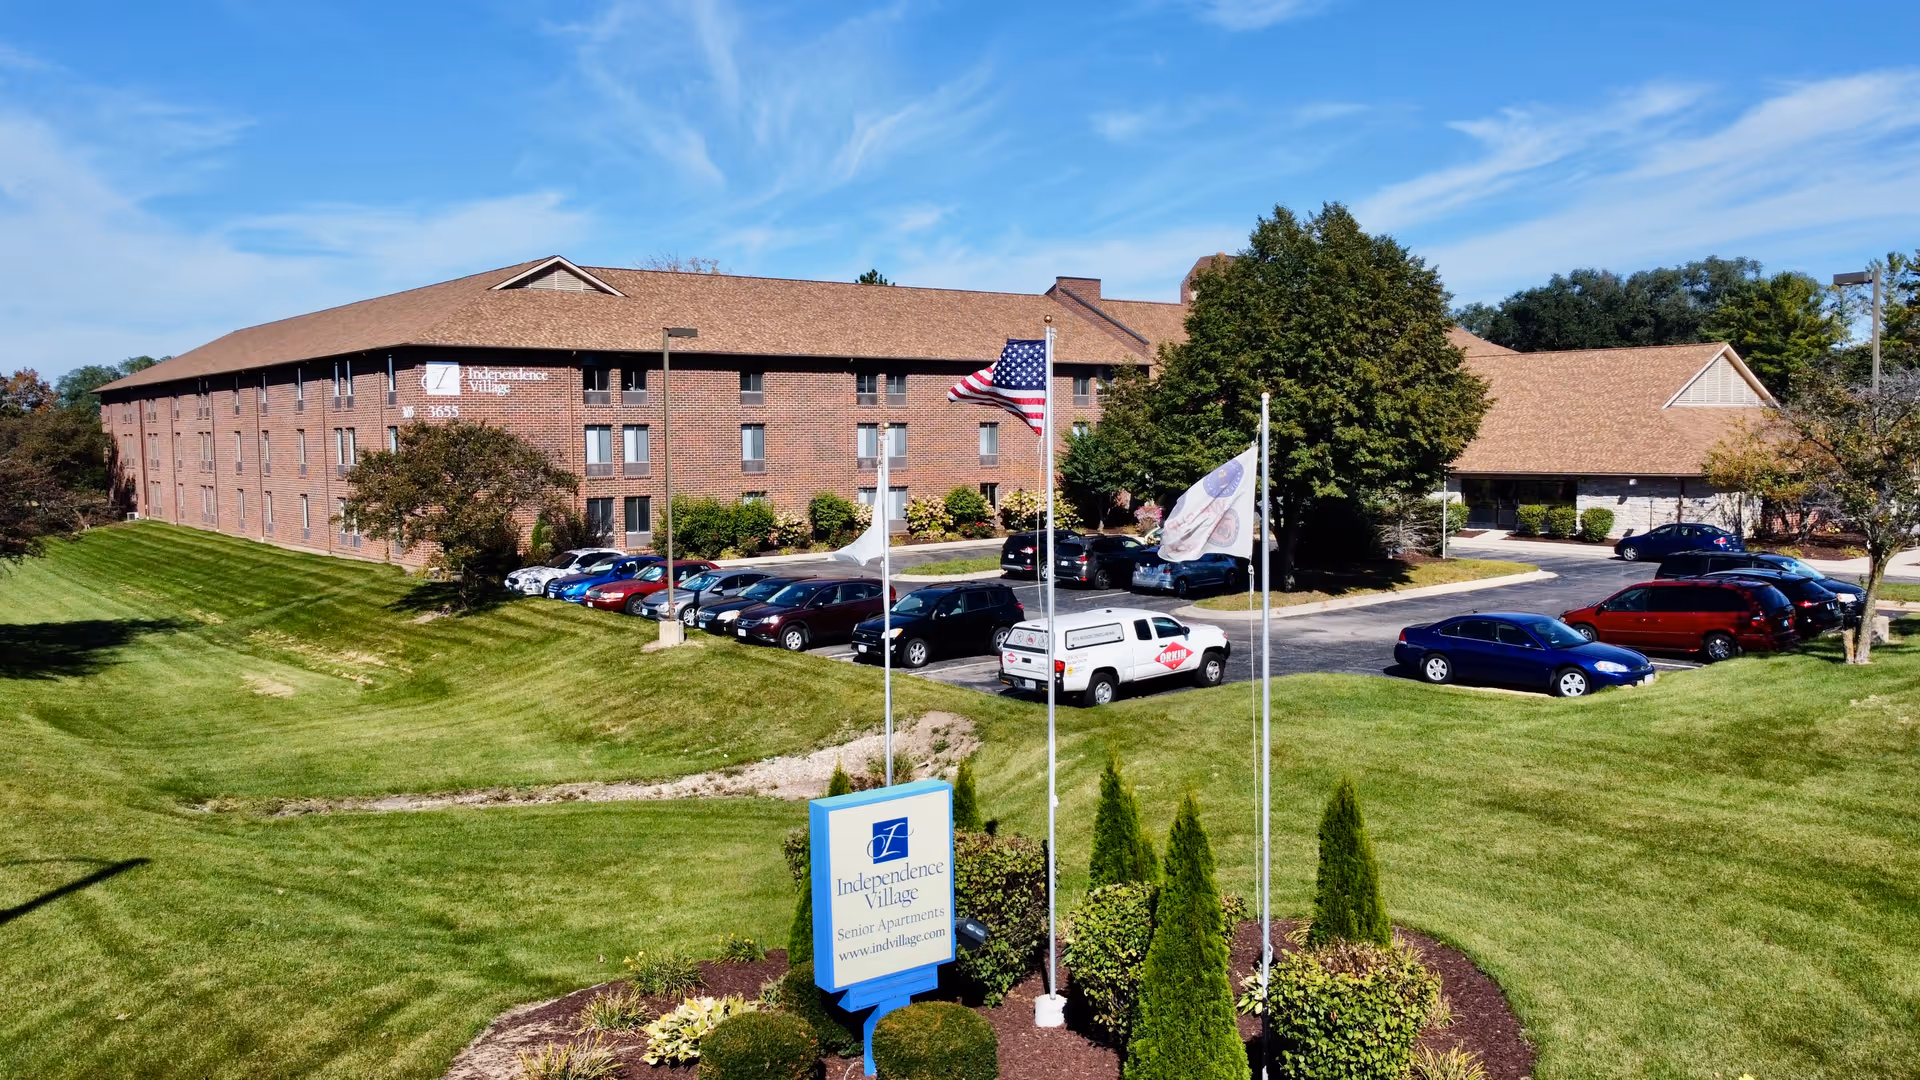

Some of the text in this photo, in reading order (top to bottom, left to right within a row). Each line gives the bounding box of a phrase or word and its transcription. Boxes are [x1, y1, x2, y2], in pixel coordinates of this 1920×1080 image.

[468, 366, 549, 382] Independence
[469, 380, 511, 397] Village
[428, 405, 460, 418] 3655
[1160, 648, 1187, 664] ORKIN
[837, 861, 944, 896] Independence
[864, 886, 919, 910] Village
[837, 907, 945, 941] Senior Apartments
[838, 928, 946, 961] www.indvillage.com
